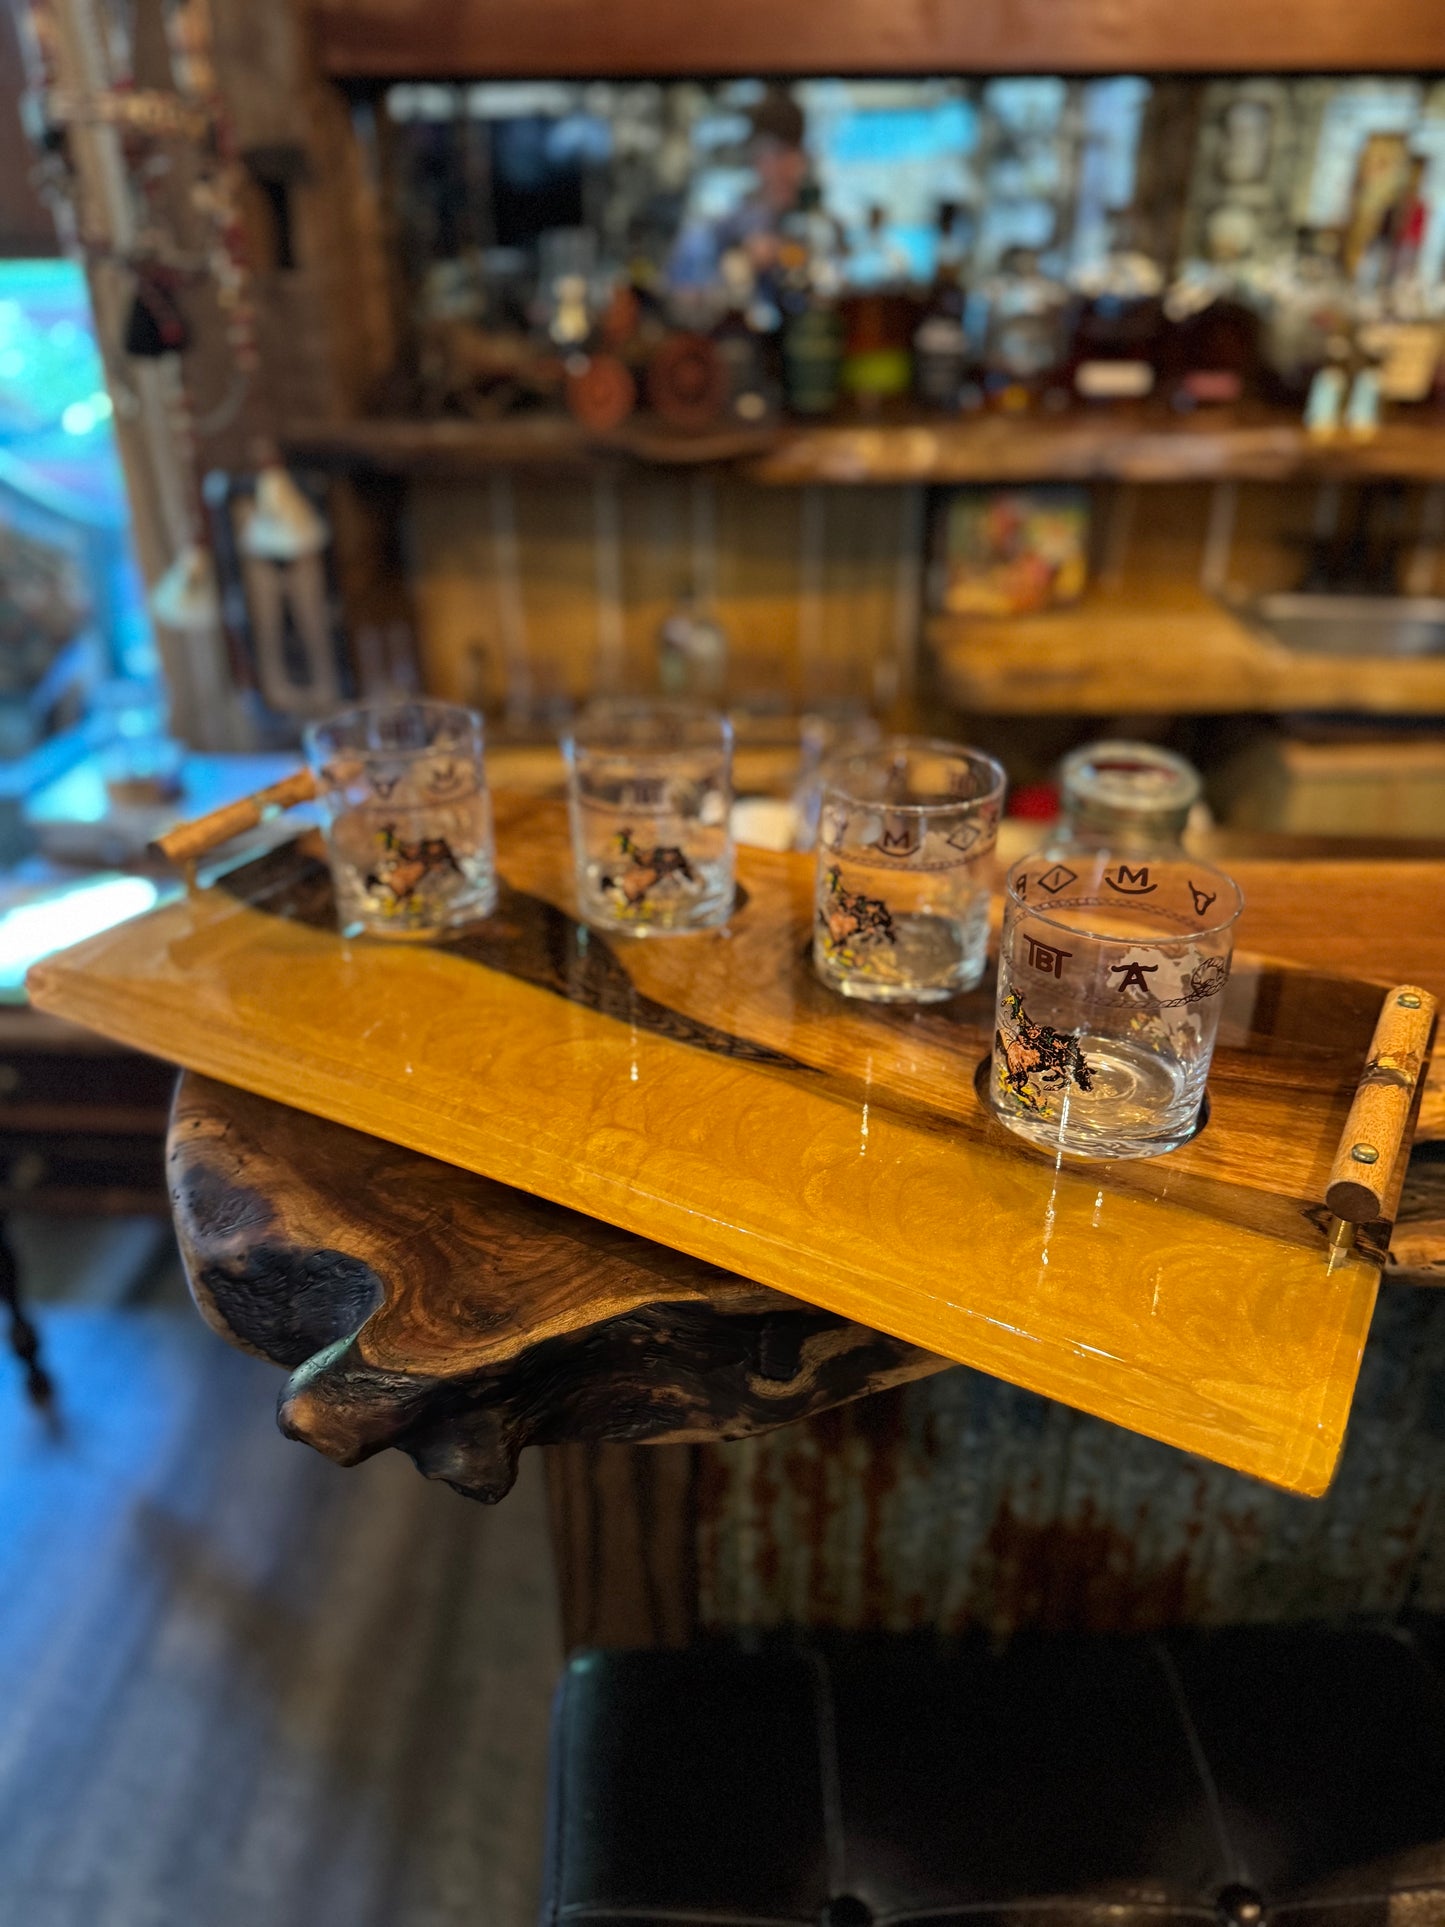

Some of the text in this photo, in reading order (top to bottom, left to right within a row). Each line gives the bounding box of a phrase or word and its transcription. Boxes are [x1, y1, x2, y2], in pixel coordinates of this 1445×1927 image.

[883, 830, 910, 849] M
[1117, 865, 1149, 887] M
[1023, 934, 1073, 979] TBT
[1111, 962, 1158, 992] A
